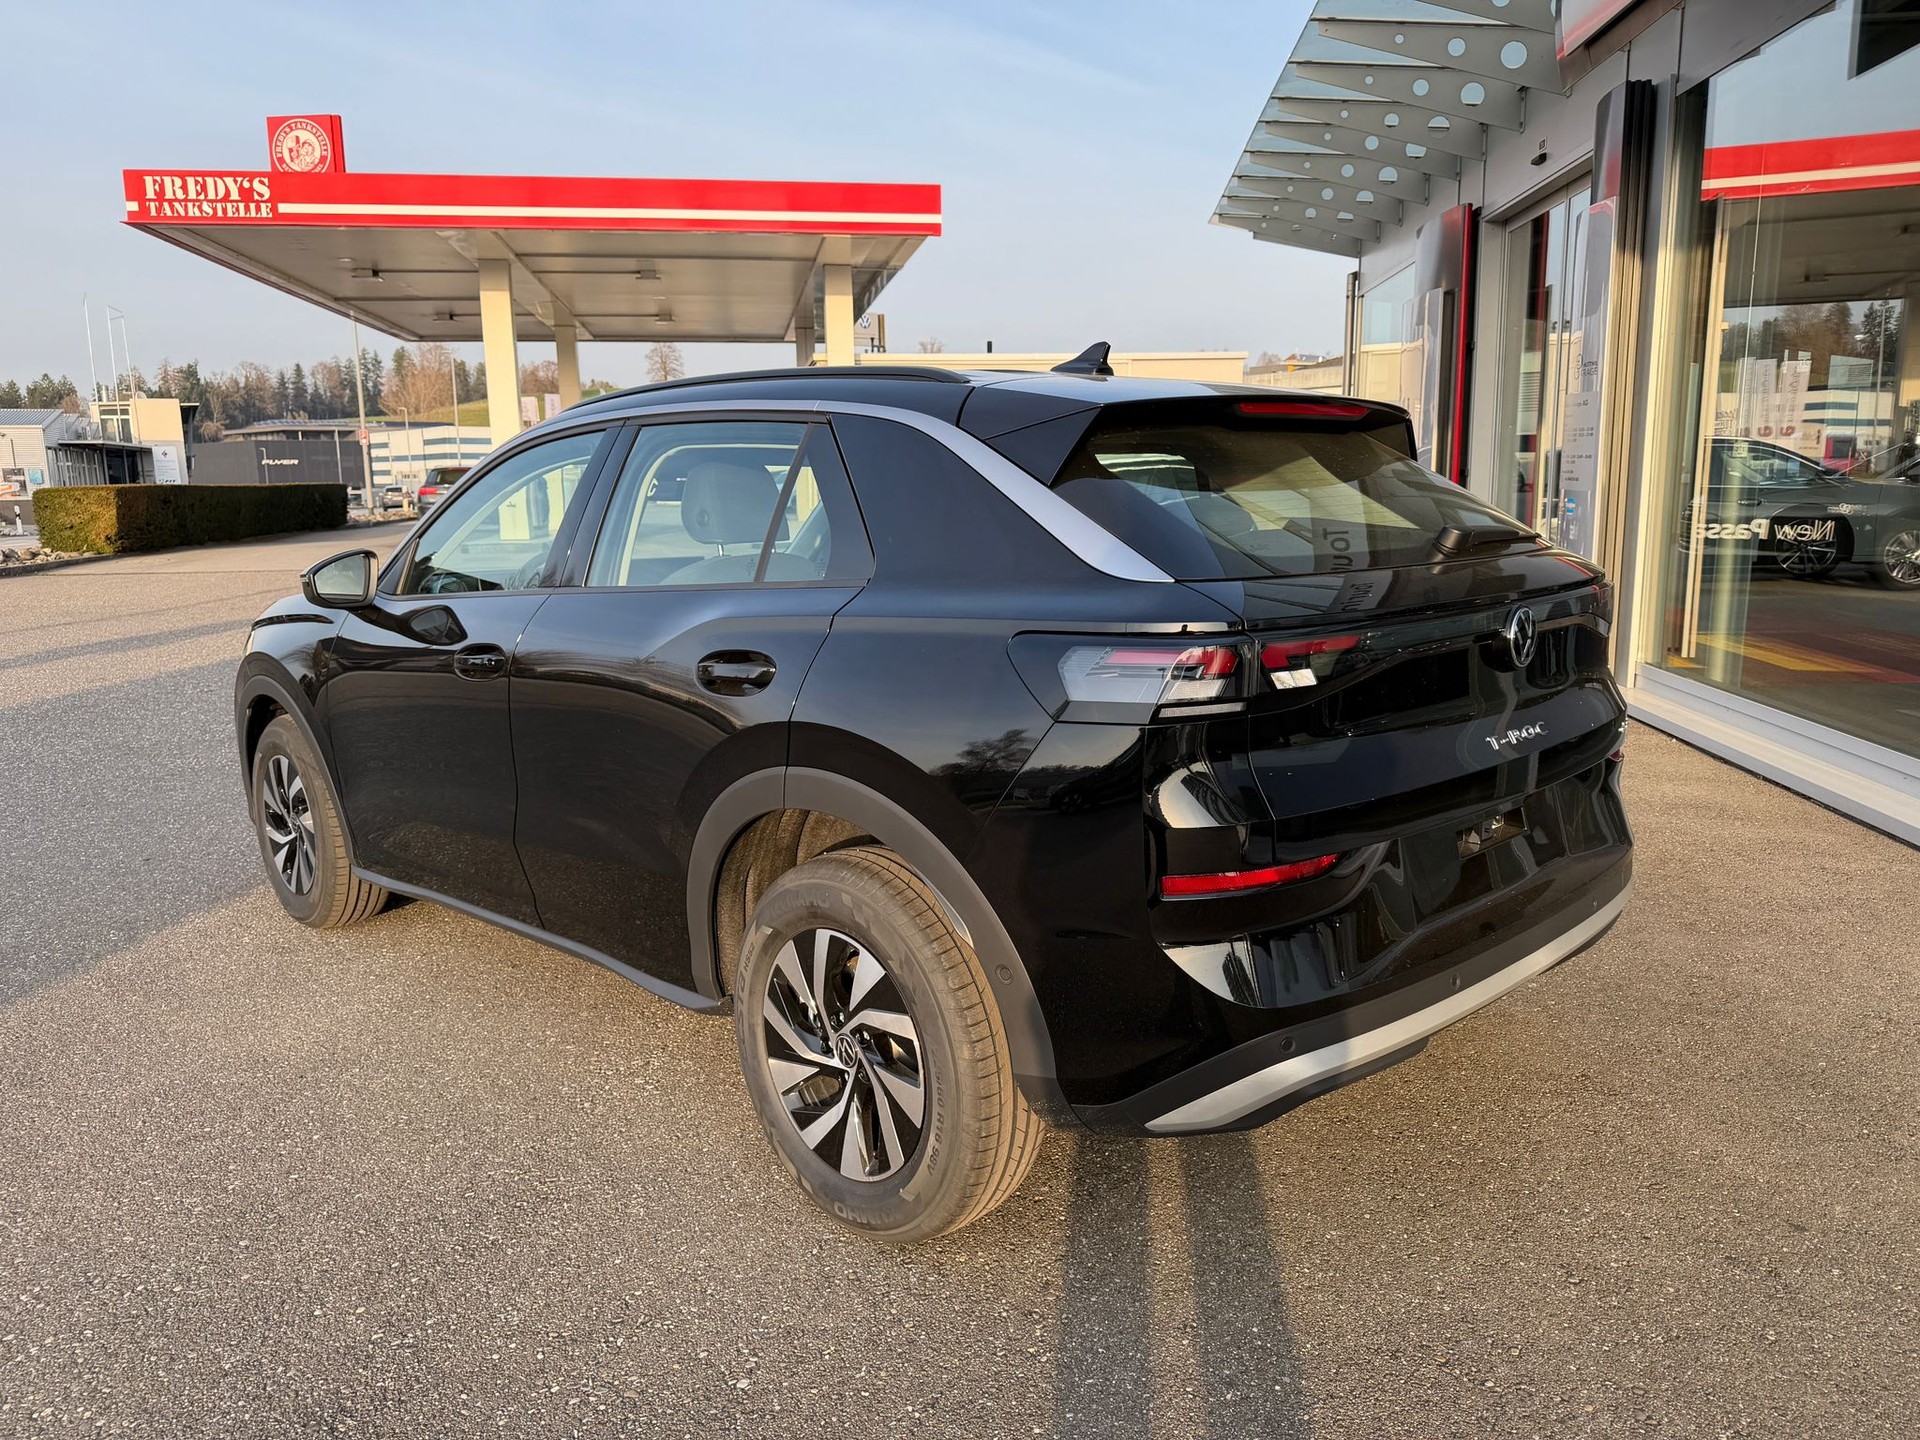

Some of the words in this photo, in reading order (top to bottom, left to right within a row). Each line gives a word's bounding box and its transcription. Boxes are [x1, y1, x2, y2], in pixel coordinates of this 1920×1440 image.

[291, 122, 328, 157] TANKSTELLE
[143, 175, 271, 201] FREDY'S
[146, 201, 273, 218] TANKSTELLE
[1485, 721, 1549, 751] T-ROC
